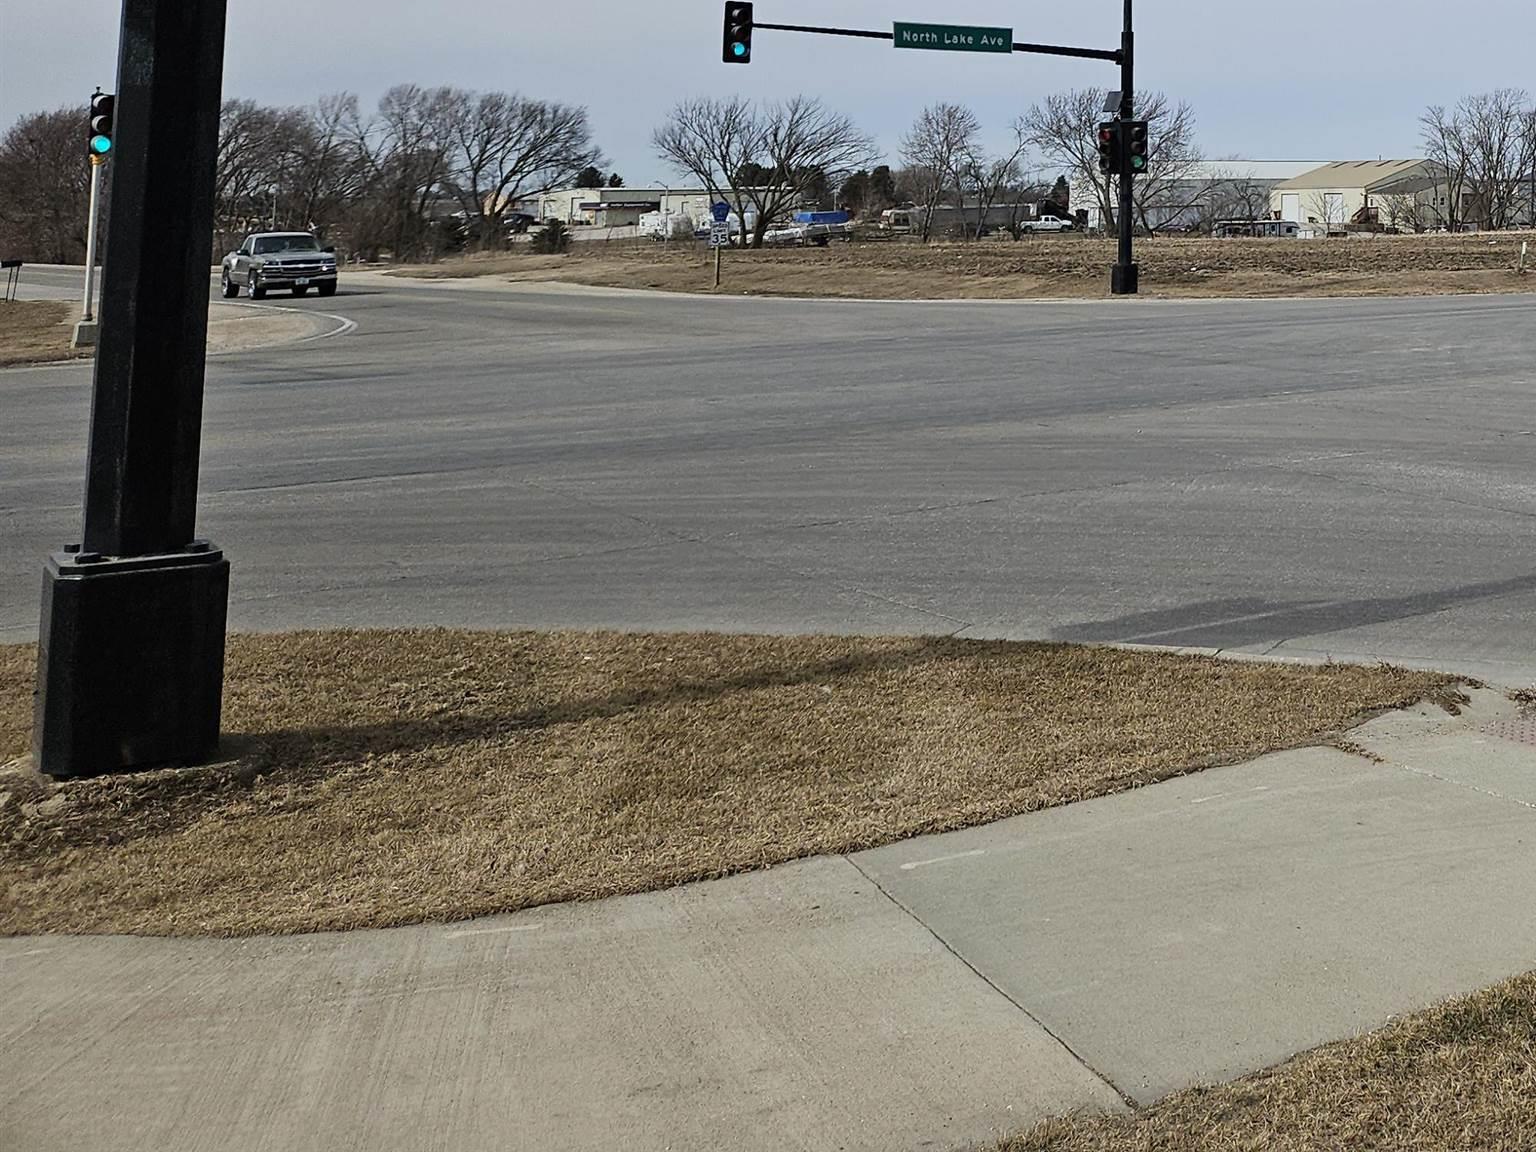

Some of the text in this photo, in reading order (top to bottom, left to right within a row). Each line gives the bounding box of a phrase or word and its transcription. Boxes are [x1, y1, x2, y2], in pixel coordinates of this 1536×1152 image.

[902, 30, 1004, 46] North Lake Ave
[712, 234, 727, 243] 35
